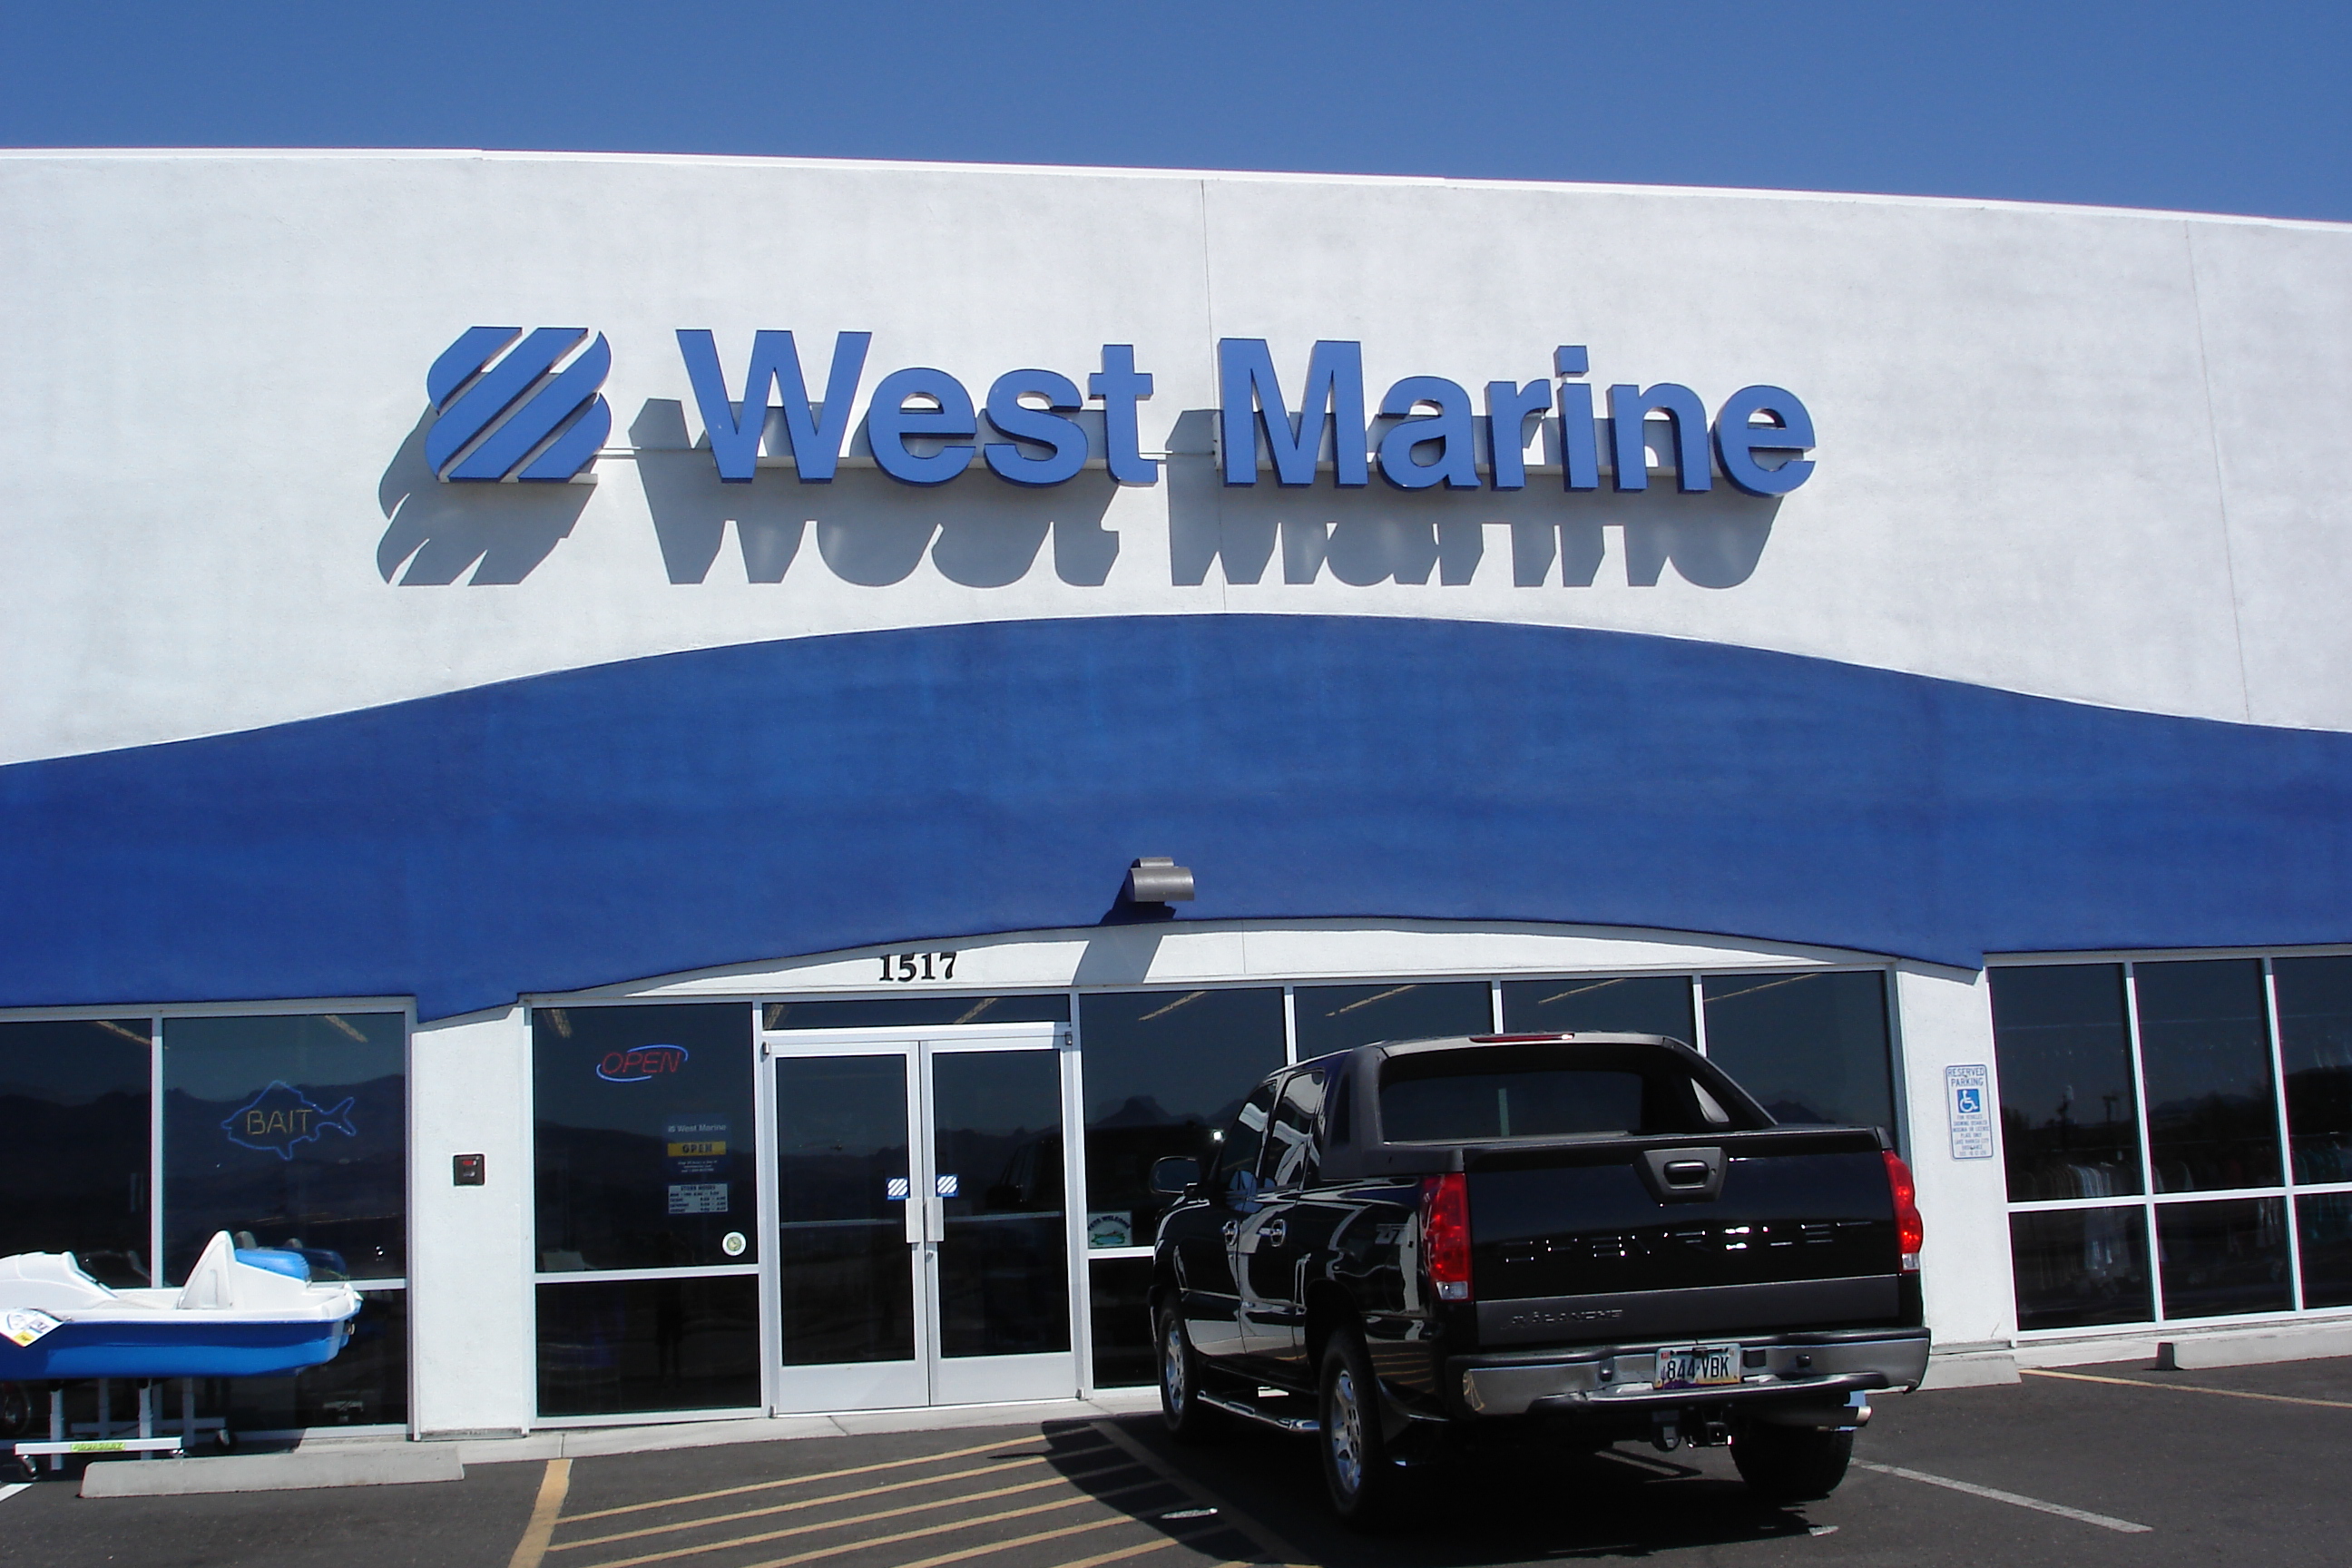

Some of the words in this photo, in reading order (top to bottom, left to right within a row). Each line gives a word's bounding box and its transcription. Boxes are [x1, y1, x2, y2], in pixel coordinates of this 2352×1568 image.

[675, 329, 1158, 486] West
[1217, 338, 1816, 497] Marine
[878, 951, 957, 983] 1517
[602, 1052, 681, 1073] OPEN
[1947, 1067, 1984, 1077] RESERVED
[1951, 1077, 1984, 1087] PARKING
[246, 1109, 313, 1136] BAIT
[677, 1124, 697, 1133] West
[699, 1123, 727, 1132] Marine
[682, 1143, 712, 1153] OPEN
